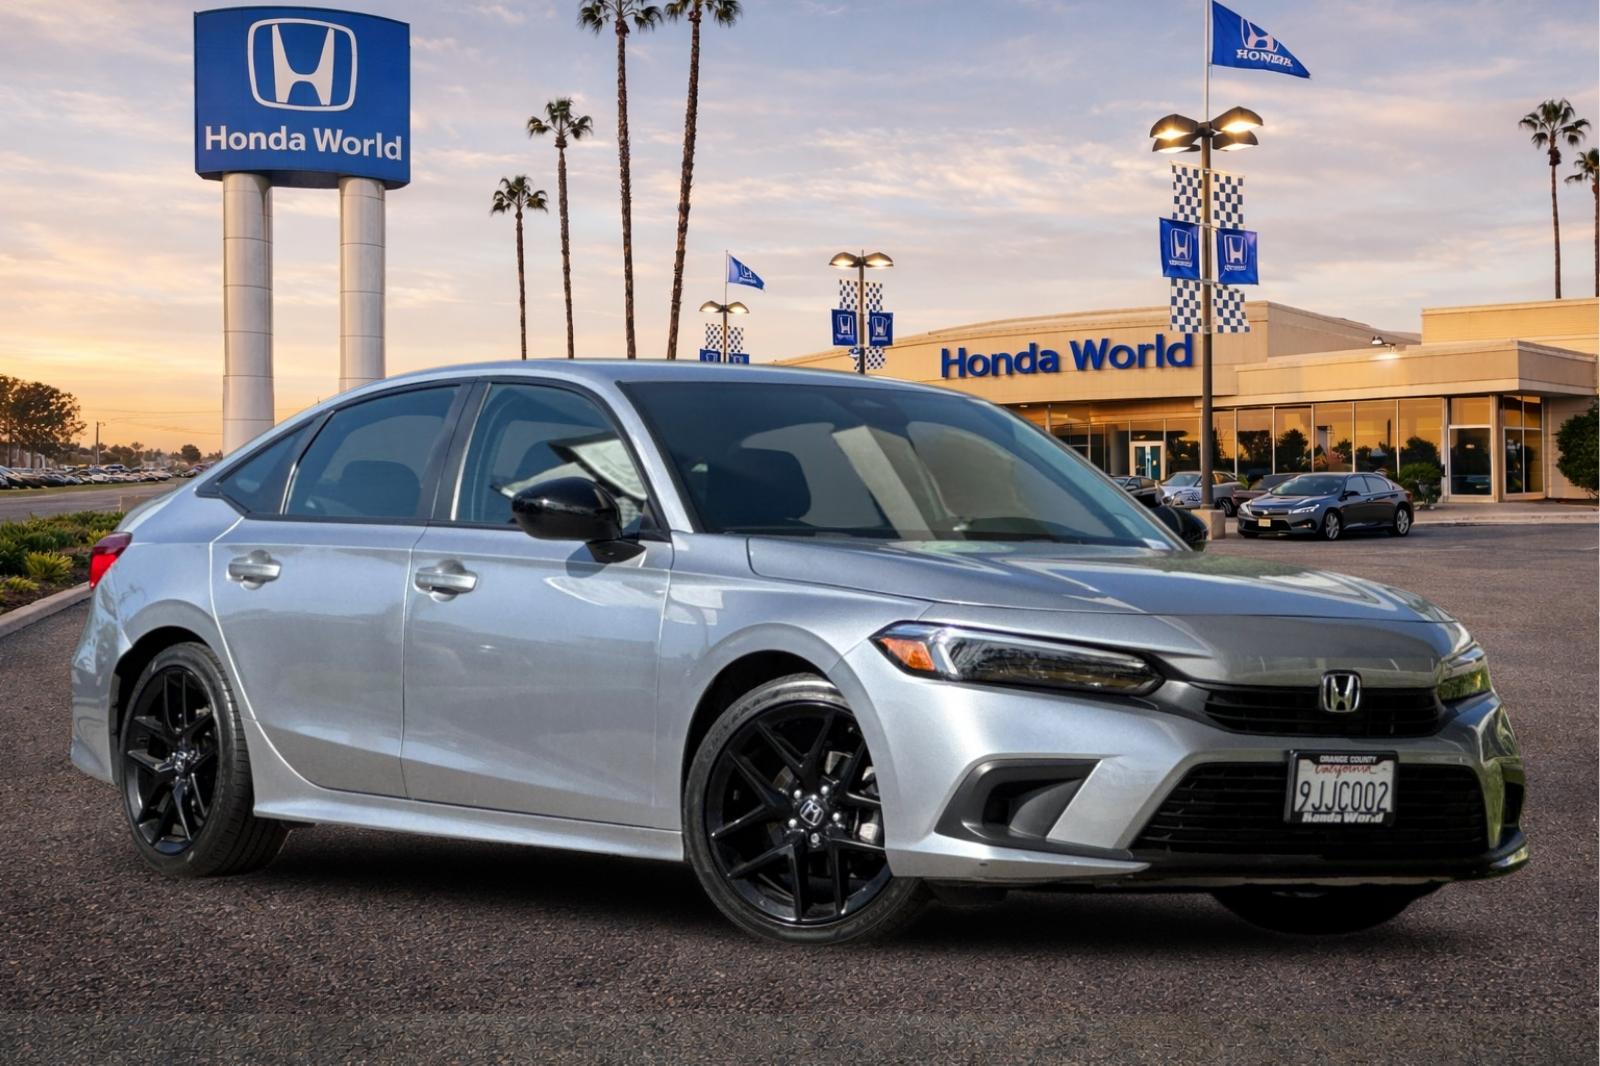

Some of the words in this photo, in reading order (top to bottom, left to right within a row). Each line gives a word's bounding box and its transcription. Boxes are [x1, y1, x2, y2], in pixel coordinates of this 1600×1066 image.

[205, 125, 306, 151] Honda
[313, 127, 402, 161] World
[941, 342, 1060, 379] Honda
[1069, 333, 1194, 371] World
[1319, 755, 1348, 763] ORANGE
[1350, 755, 1377, 763] COUNTY
[1299, 780, 1389, 812] 9JJC002
